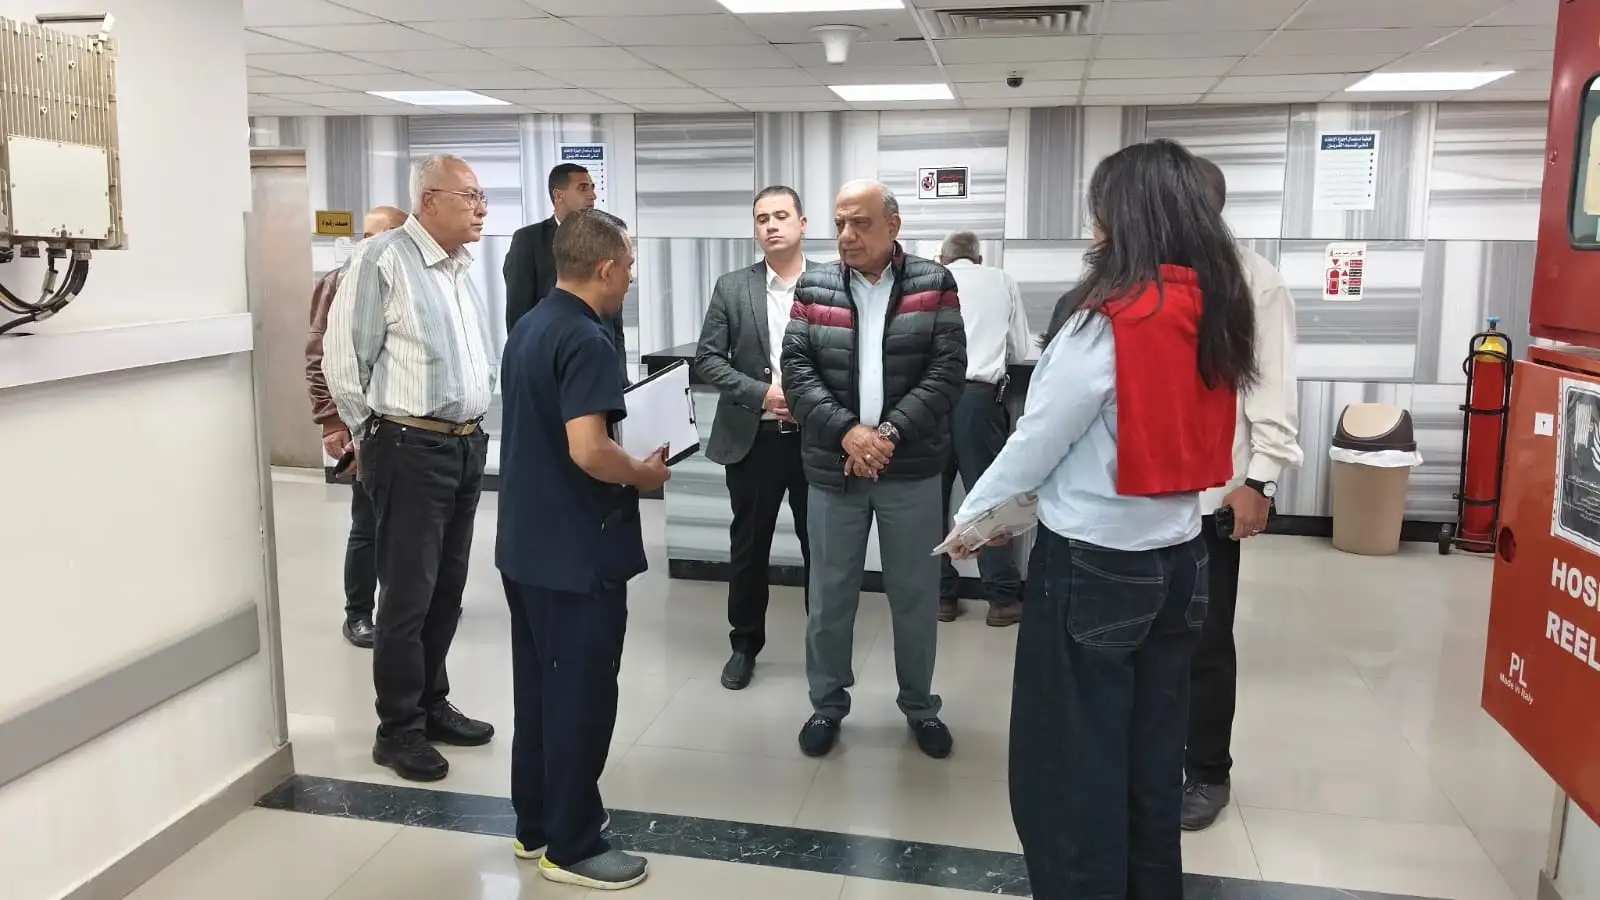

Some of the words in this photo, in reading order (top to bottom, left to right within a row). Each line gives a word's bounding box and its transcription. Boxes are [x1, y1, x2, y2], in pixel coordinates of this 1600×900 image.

[1551, 557, 1600, 612] HOS
[1545, 610, 1600, 672] REEL
[1499, 672, 1514, 690] Made
[1514, 684, 1521, 695] in
[1520, 687, 1534, 705] Italy
[1509, 652, 1527, 688] PL
